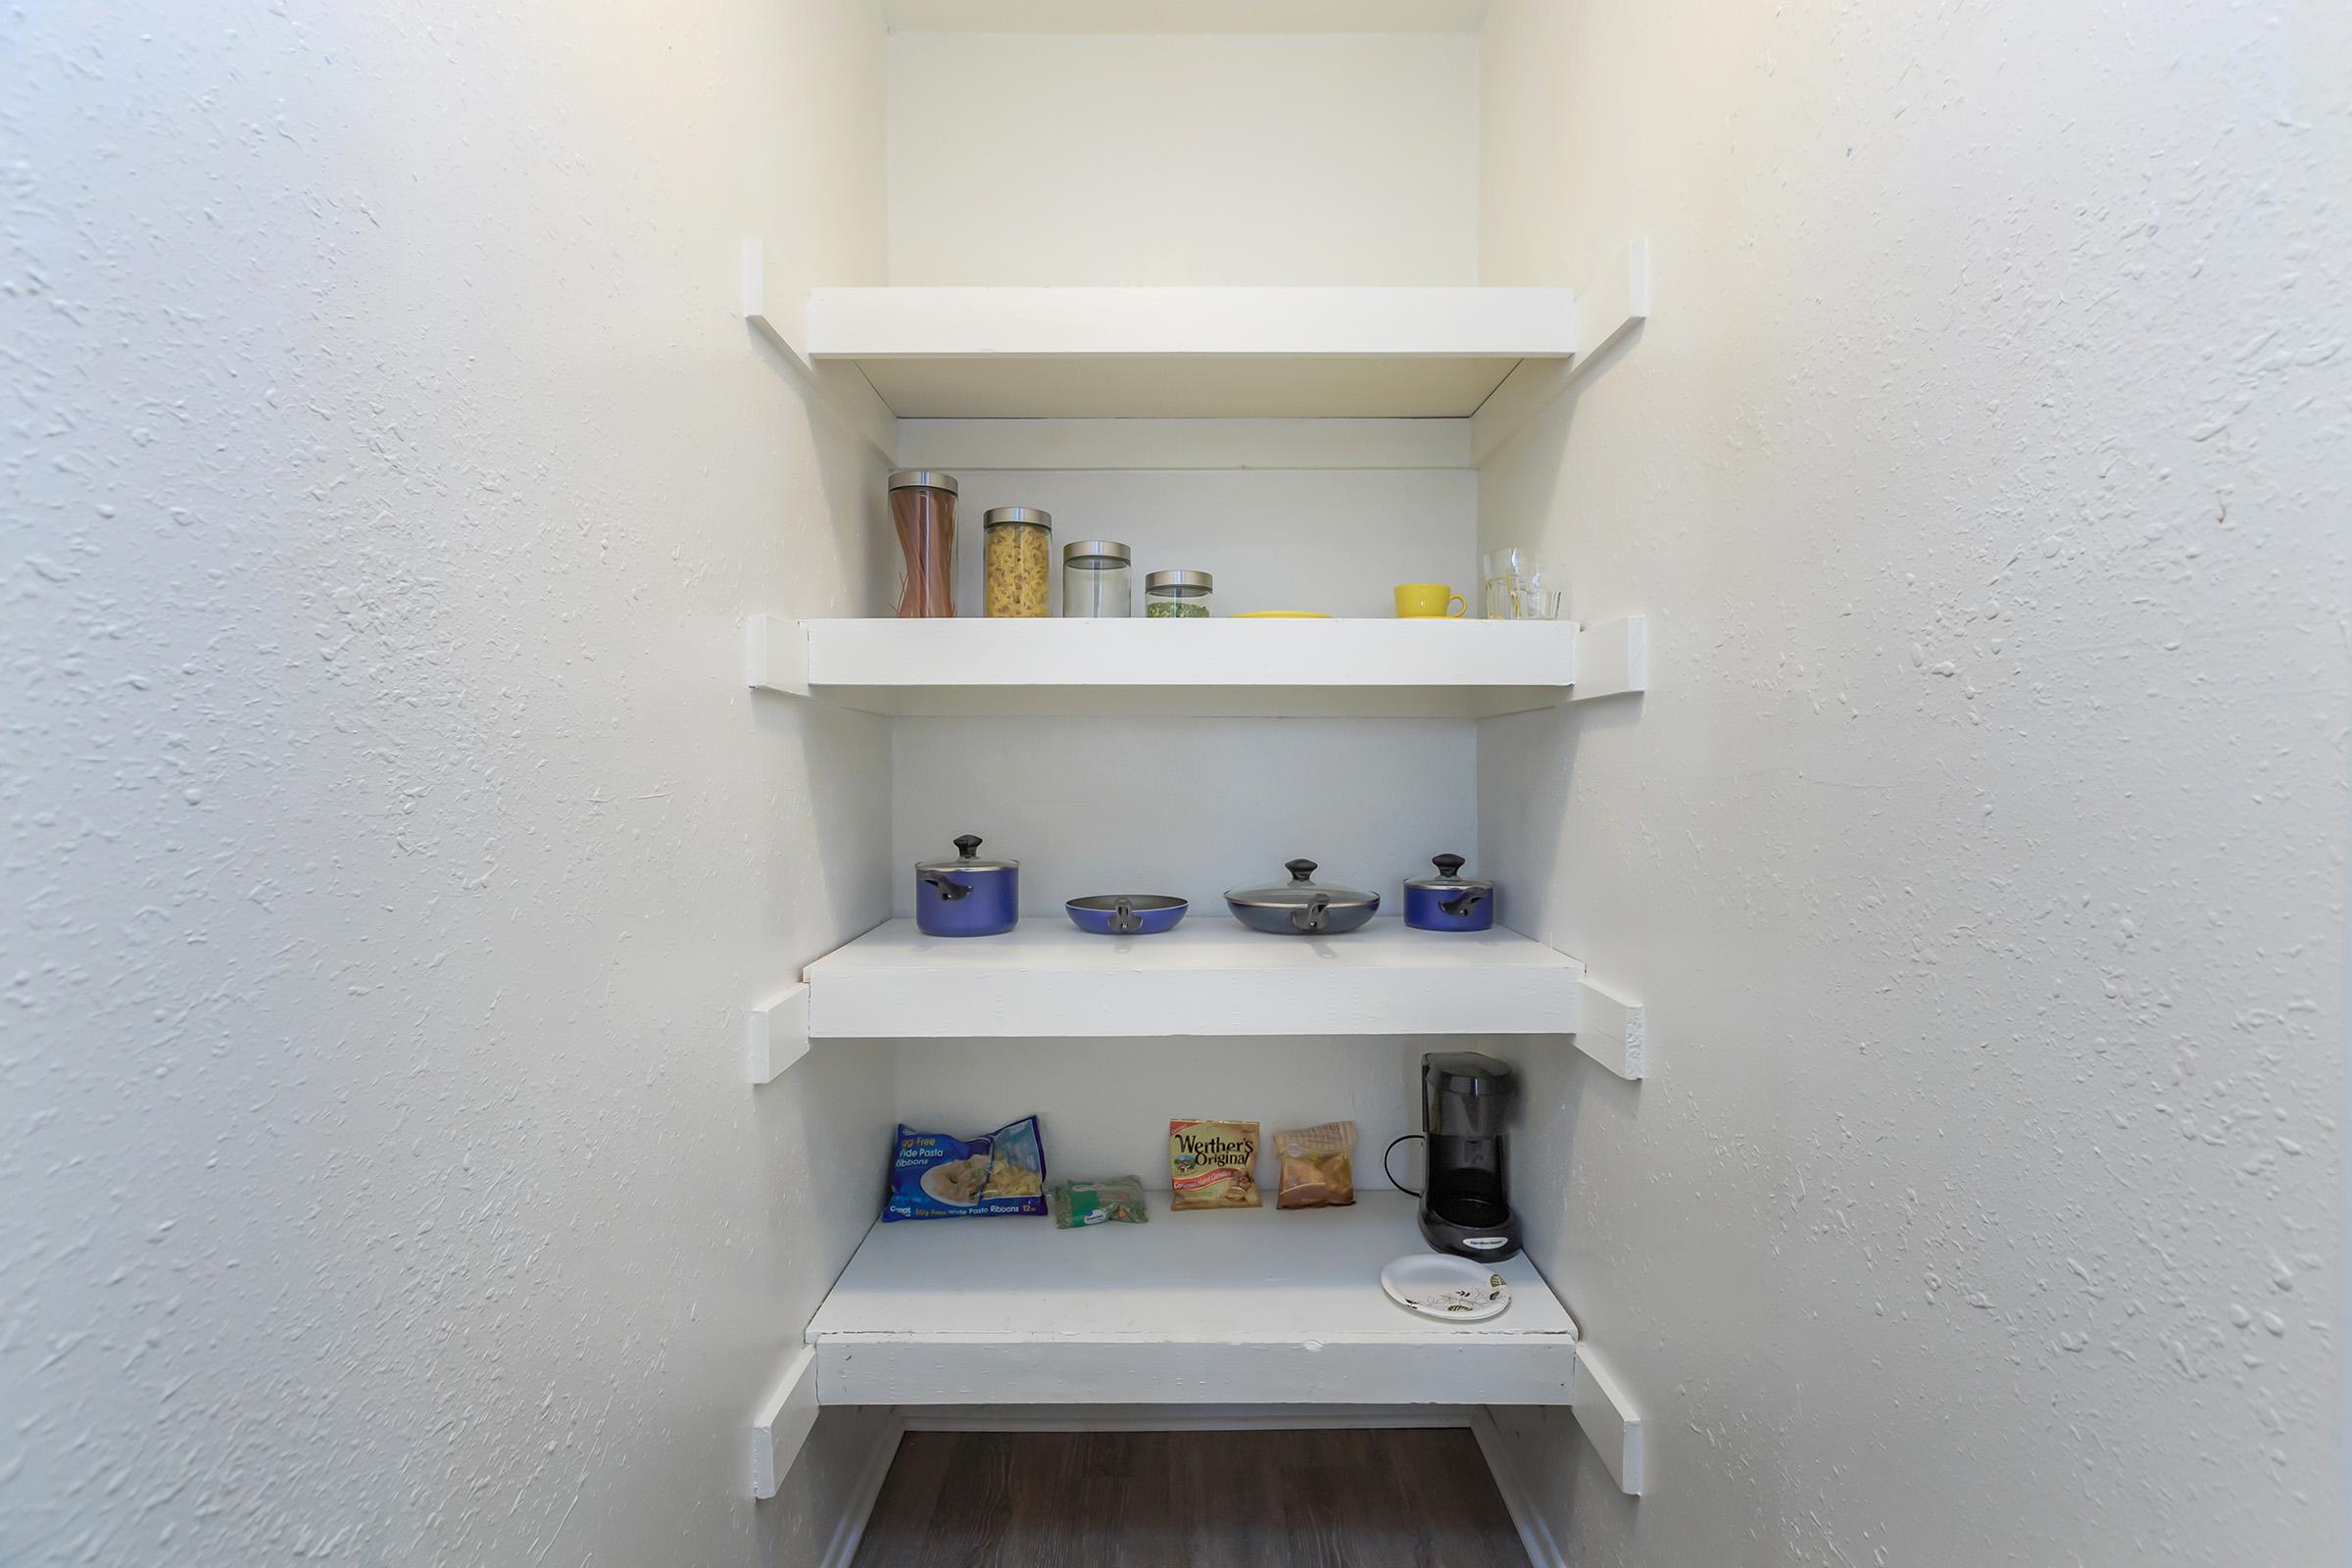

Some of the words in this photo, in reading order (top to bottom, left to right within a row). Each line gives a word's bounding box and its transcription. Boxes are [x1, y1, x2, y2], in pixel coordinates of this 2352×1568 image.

[1174, 1134, 1253, 1152] Werther's
[919, 1148, 944, 1157] Pasta
[1195, 1152, 1250, 1166] Original
[968, 1206, 989, 1215] Pasta
